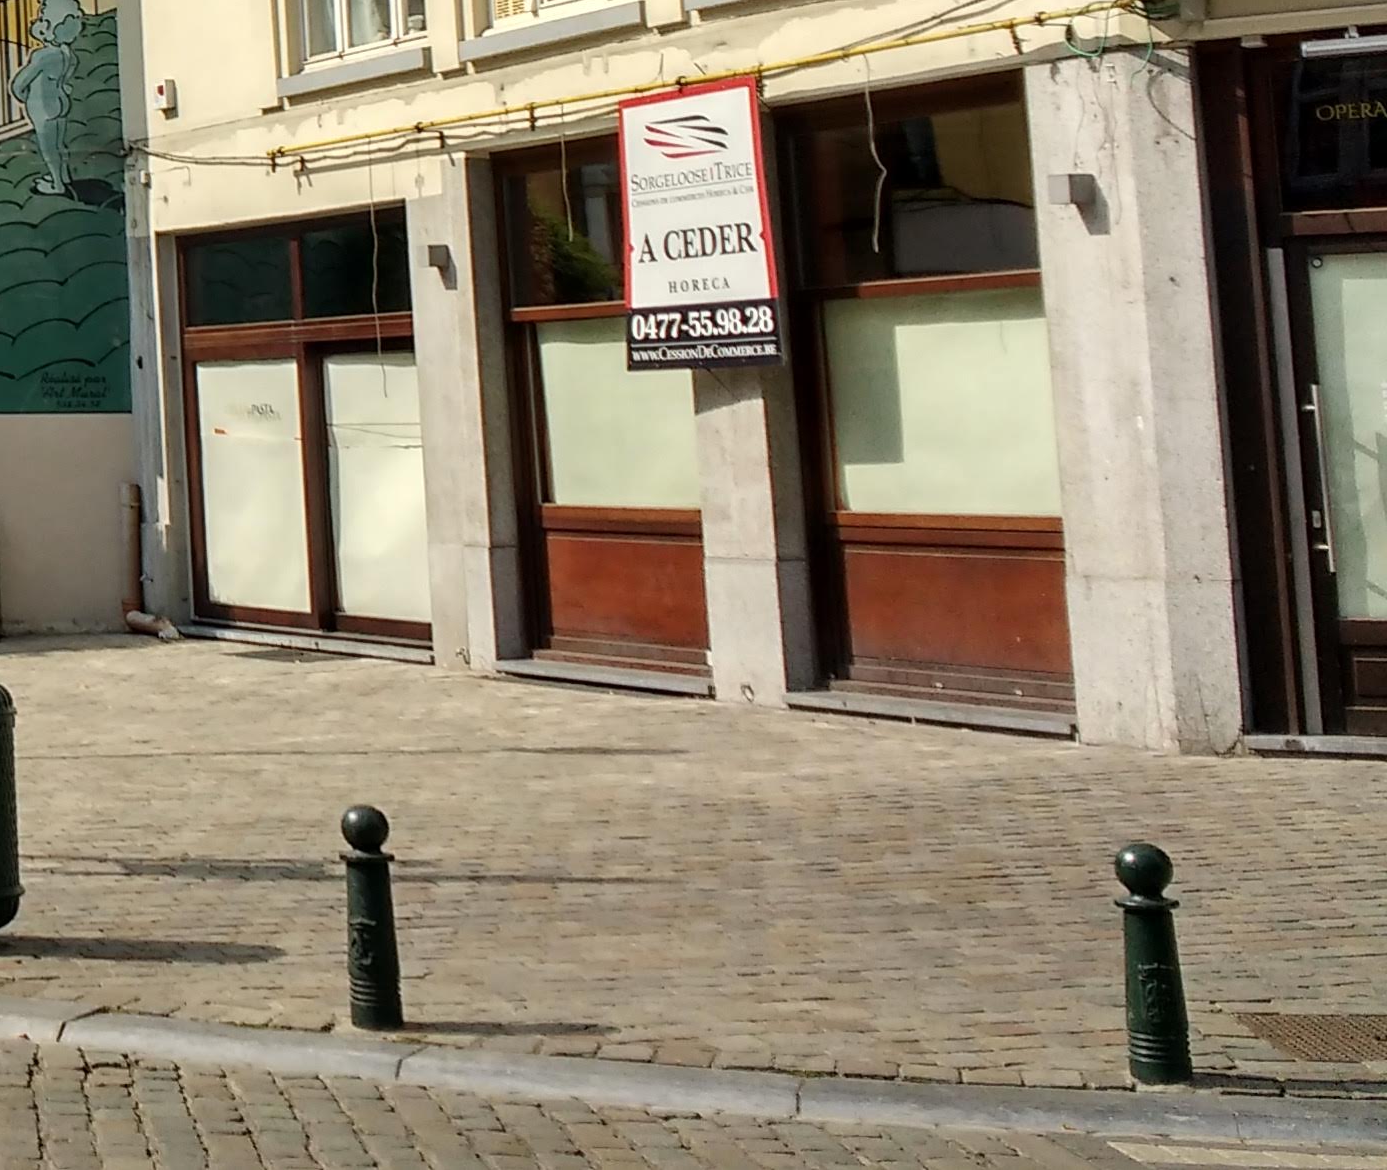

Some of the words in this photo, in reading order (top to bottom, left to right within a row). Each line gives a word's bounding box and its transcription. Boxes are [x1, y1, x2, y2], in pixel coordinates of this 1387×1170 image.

[638, 233, 658, 263] A
[663, 222, 758, 261] CEDER
[668, 277, 731, 293] HORECA
[631, 305, 774, 340] 0477-55.98.28
